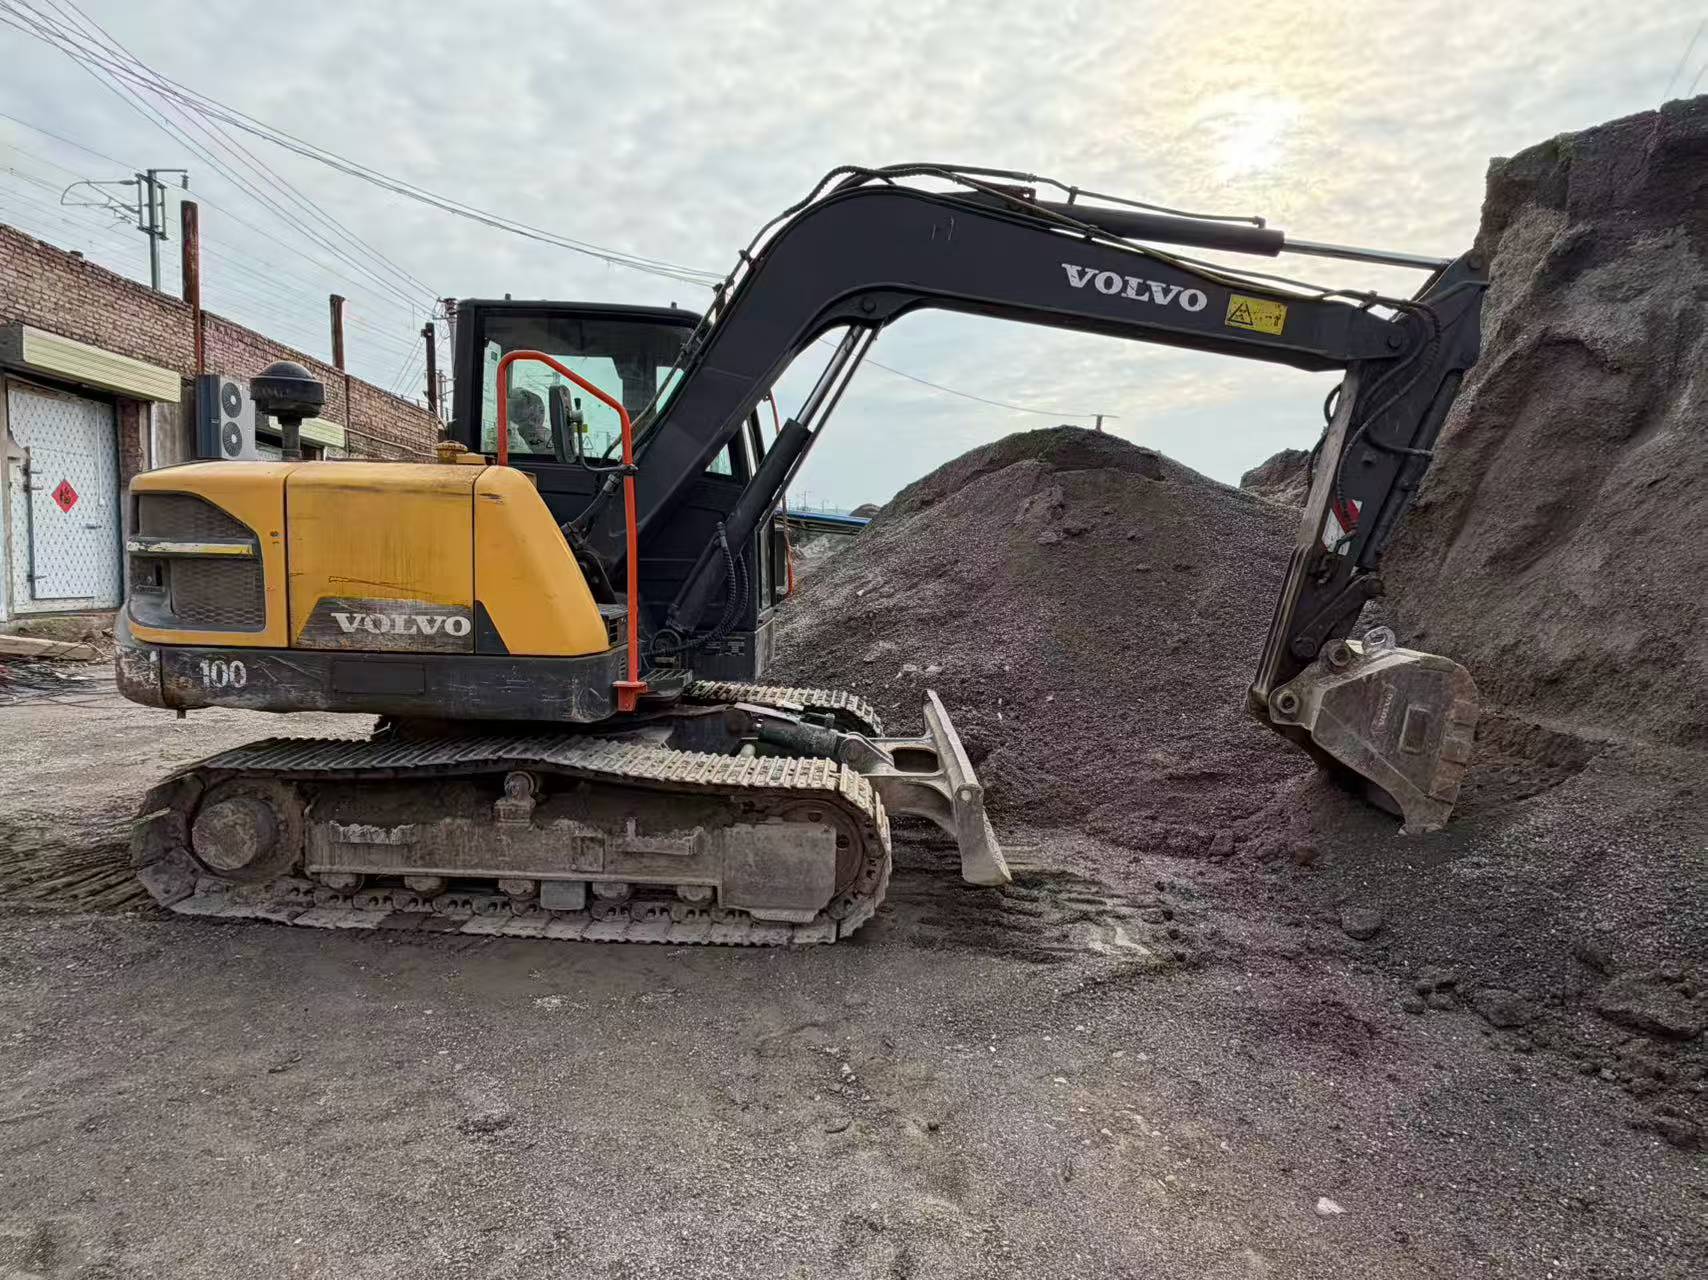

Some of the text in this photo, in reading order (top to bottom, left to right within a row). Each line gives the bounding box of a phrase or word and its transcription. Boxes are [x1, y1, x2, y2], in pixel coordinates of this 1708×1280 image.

[1061, 263, 1208, 312] VOLVO
[331, 612, 471, 636] VOLVO
[199, 659, 247, 688] 100
